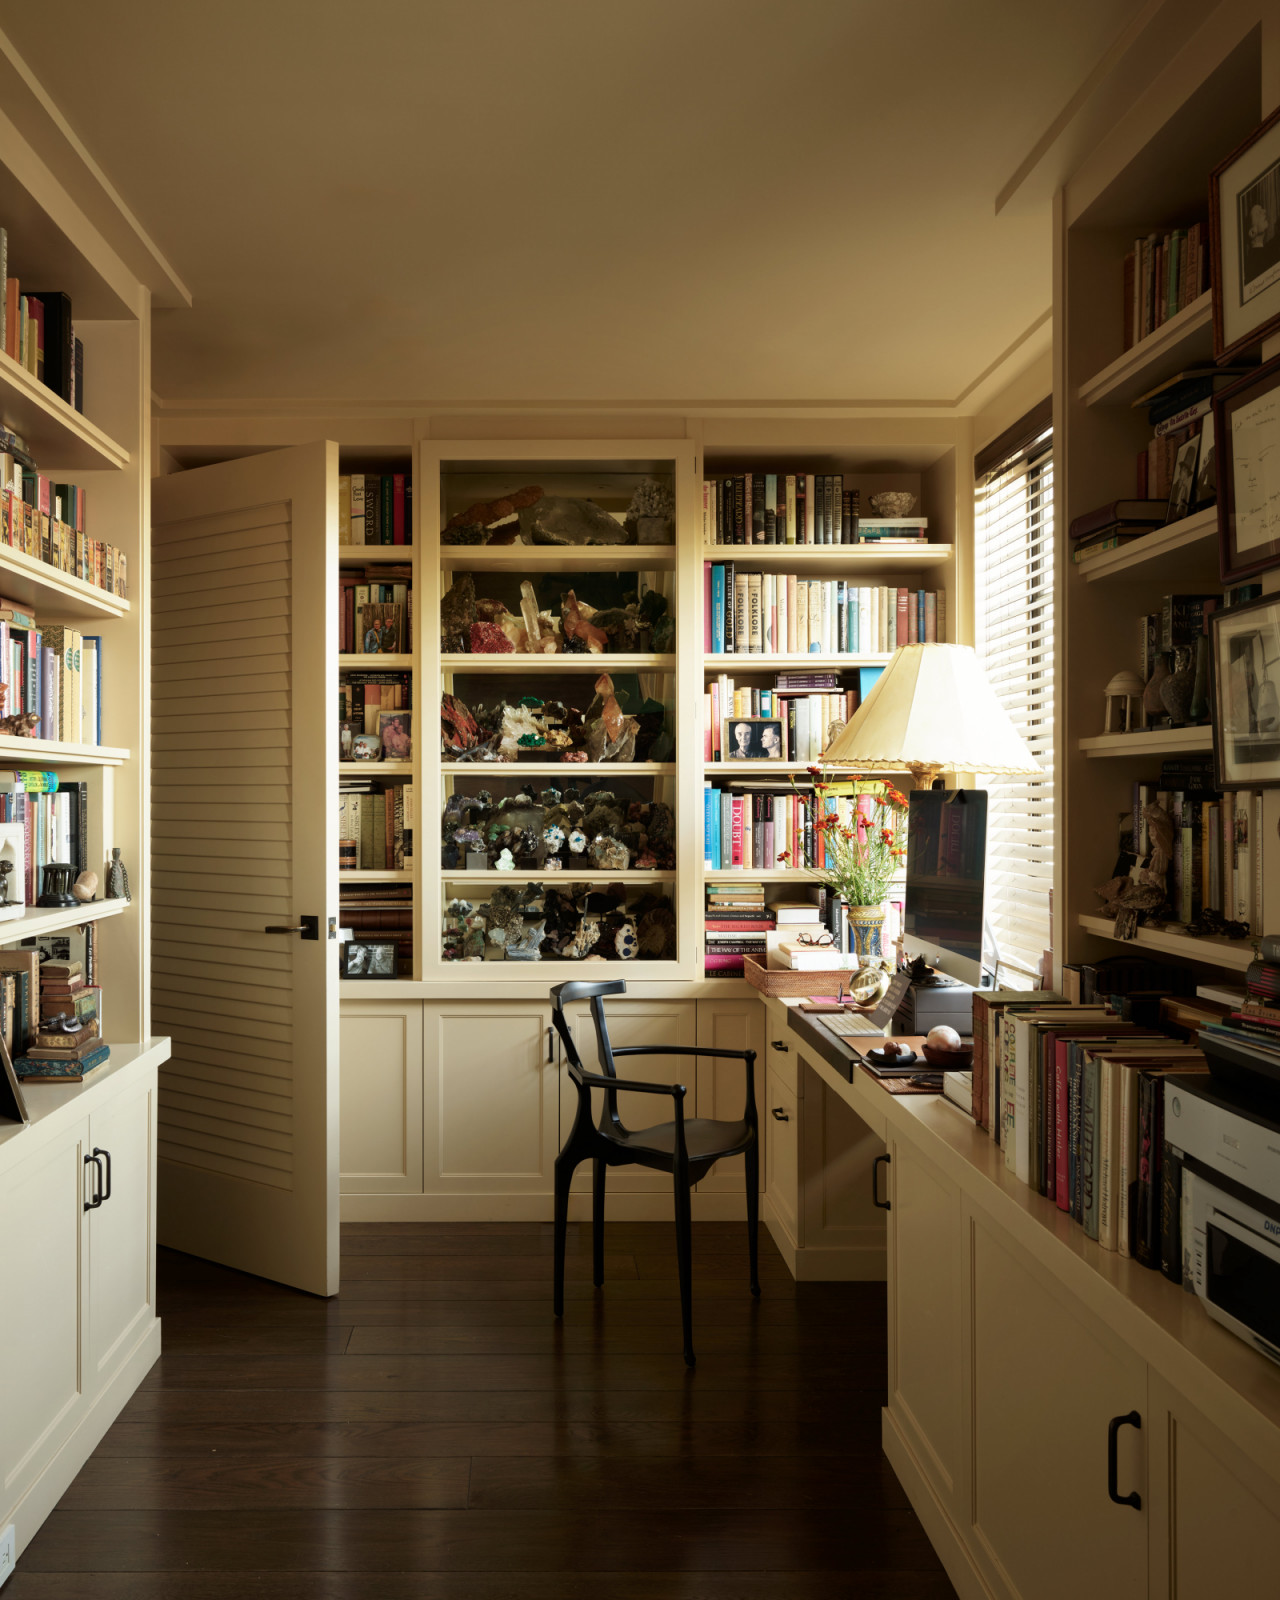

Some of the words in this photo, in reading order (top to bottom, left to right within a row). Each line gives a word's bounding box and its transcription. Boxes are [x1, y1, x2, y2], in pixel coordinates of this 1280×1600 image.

[365, 491, 374, 536] SWORD
[725, 610, 733, 639] GOLD
[733, 807, 742, 847] DOUBT
[1264, 1220, 1280, 1235] DNP
